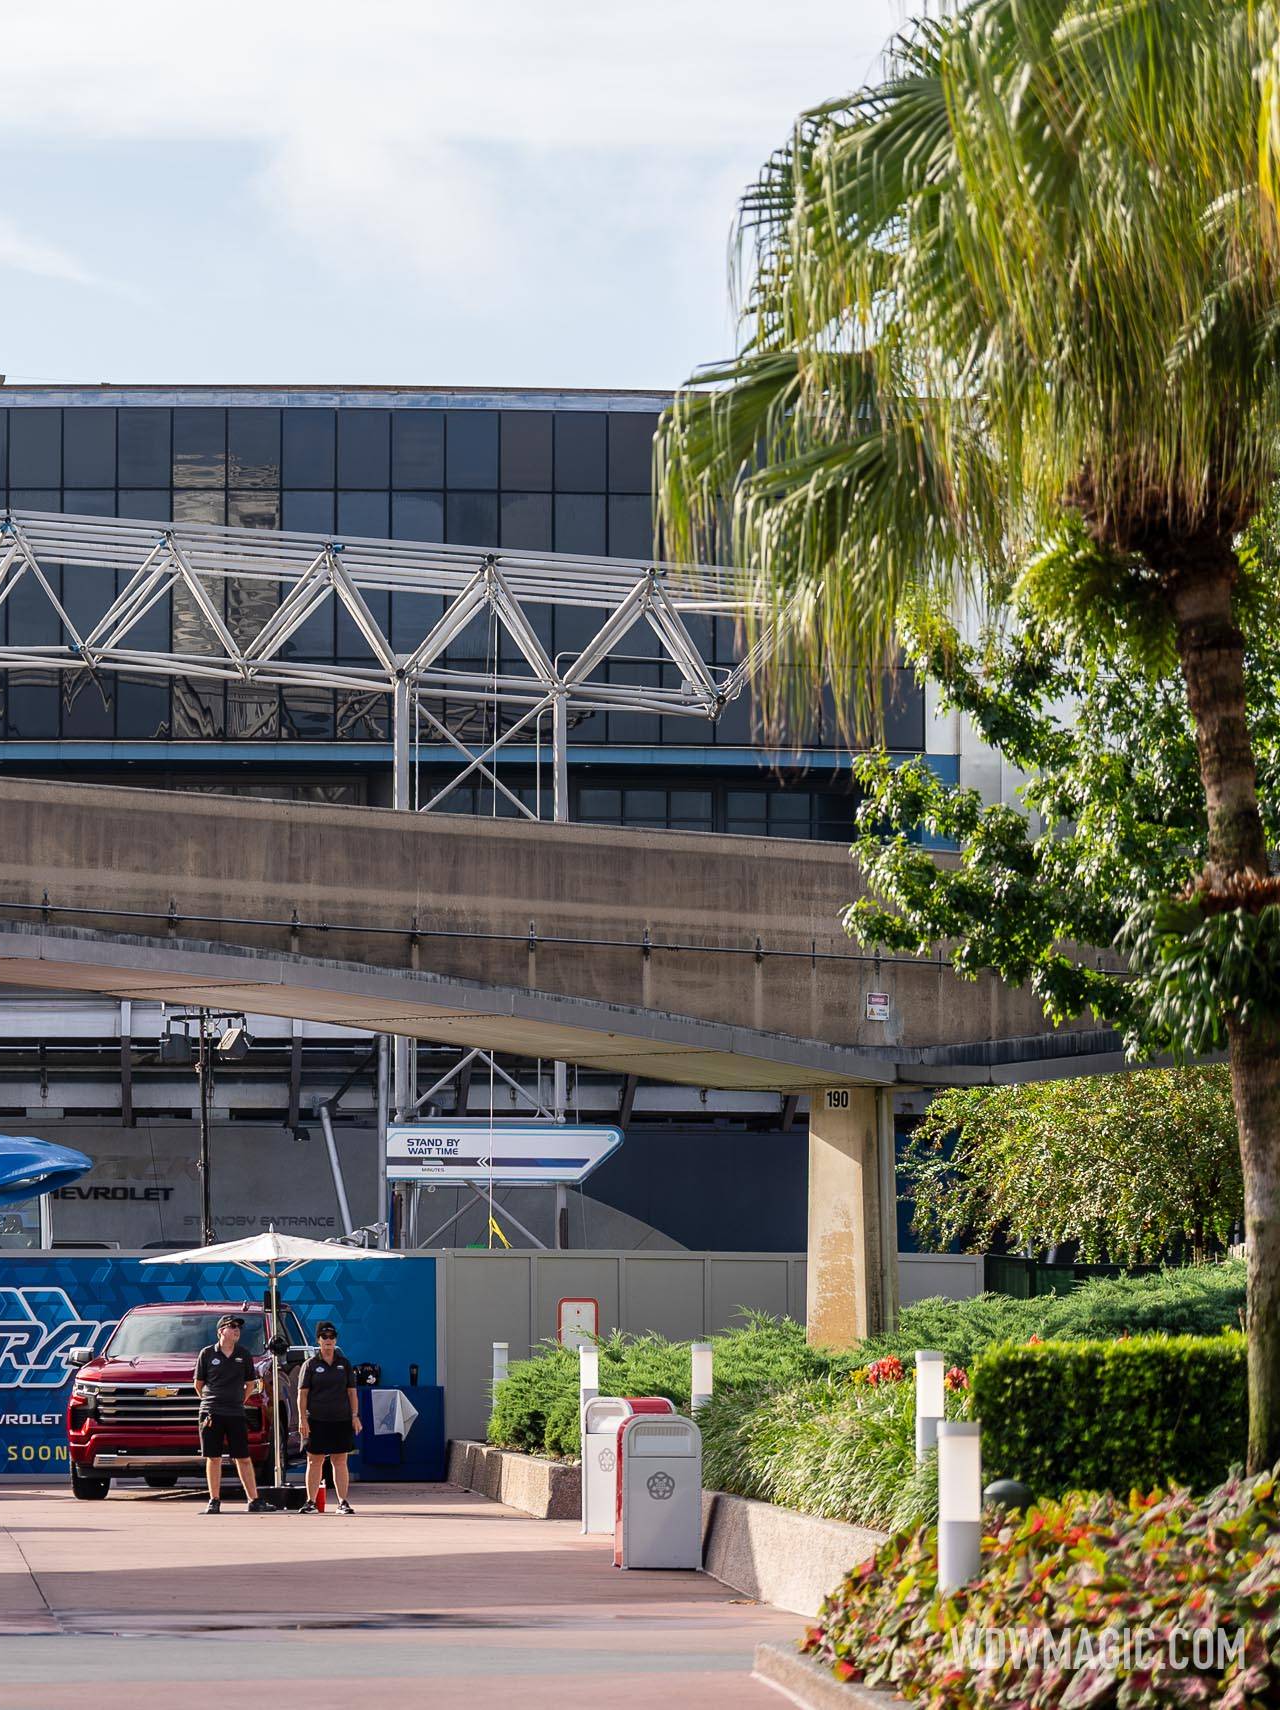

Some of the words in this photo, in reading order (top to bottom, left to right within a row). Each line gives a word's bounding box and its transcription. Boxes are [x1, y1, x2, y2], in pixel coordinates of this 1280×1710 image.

[827, 1090, 848, 1107] 190
[407, 1138, 443, 1147] STAND
[446, 1138, 461, 1147] BY
[407, 1147, 433, 1155] WAIT
[435, 1147, 459, 1155] TIME
[49, 1186, 175, 1201] EVROLET
[183, 1215, 256, 1227] STNDBY
[260, 1216, 335, 1227] ENTRANCE
[7, 1445, 68, 1461] SOON
